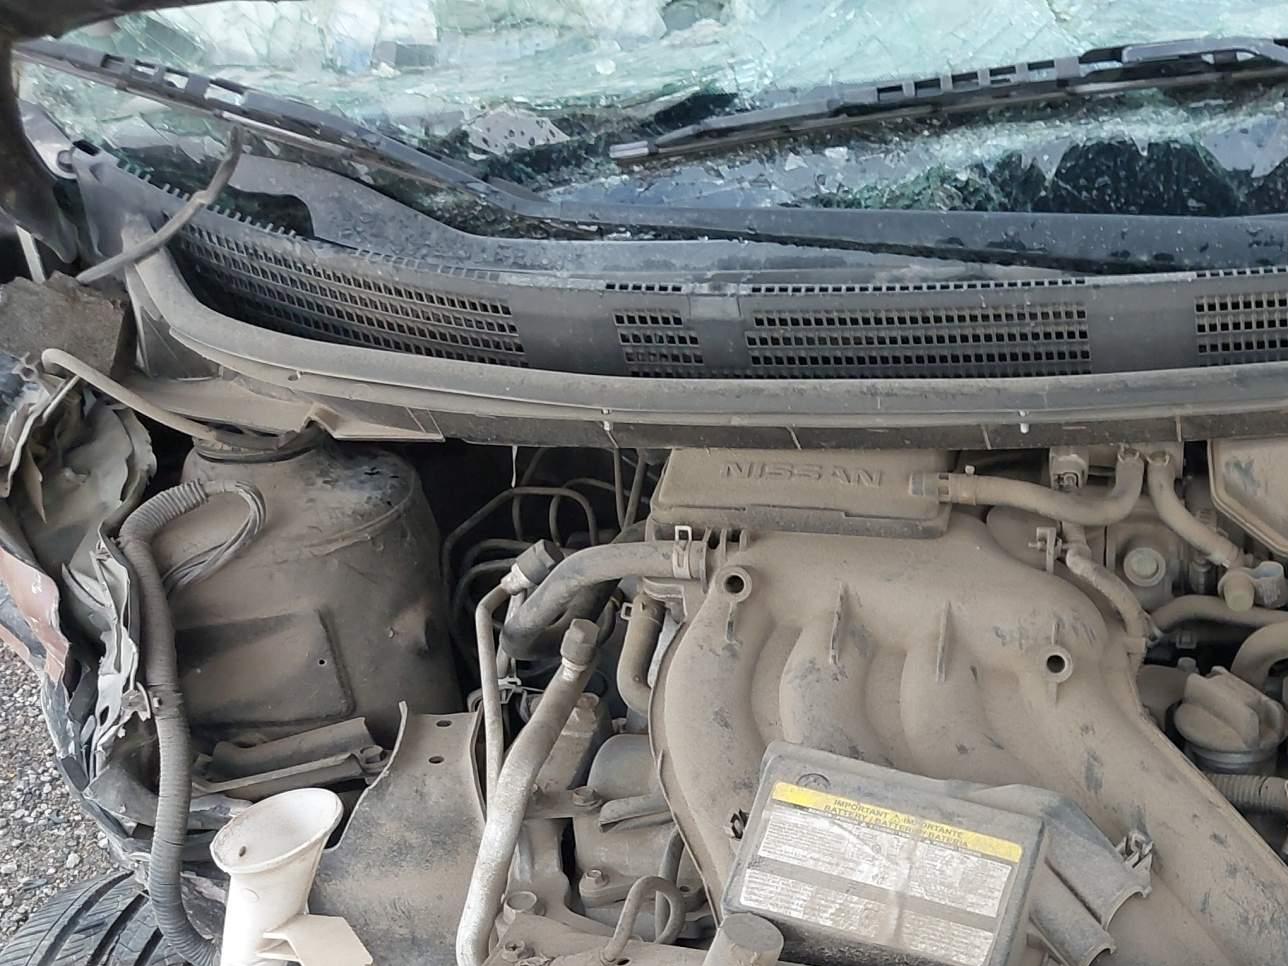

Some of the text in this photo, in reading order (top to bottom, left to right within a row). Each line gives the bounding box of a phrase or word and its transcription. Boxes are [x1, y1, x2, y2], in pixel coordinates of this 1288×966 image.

[721, 460, 884, 489] NISSAN
[824, 805, 867, 824] BATTERY
[834, 799, 963, 838] IMPORTANT IMORTANTE
